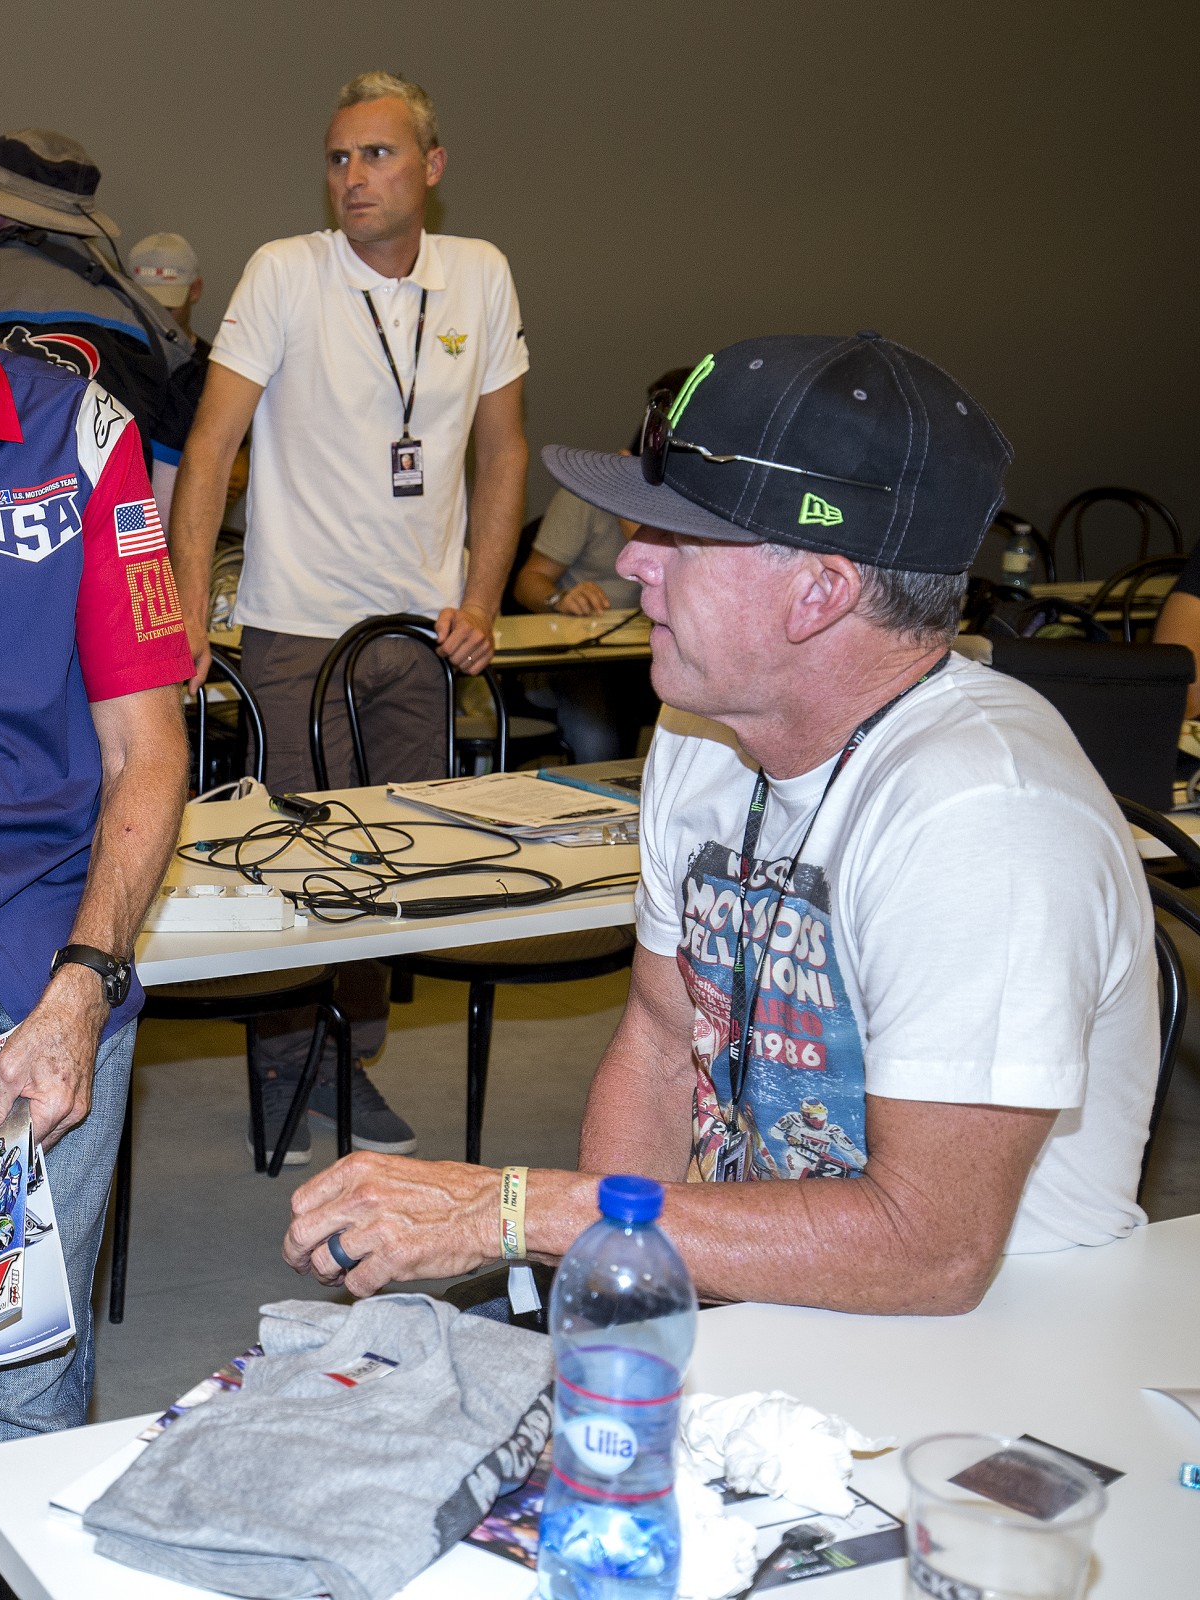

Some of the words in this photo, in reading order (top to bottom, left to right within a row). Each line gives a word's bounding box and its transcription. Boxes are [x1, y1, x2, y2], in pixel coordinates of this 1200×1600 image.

[25, 482, 60, 500] MOTOCROSS
[60, 477, 78, 488] TEAM
[753, 1031, 821, 1067] 1986
[503, 1173, 511, 1205] MAGGIORA
[584, 1425, 636, 1459] Lilia
